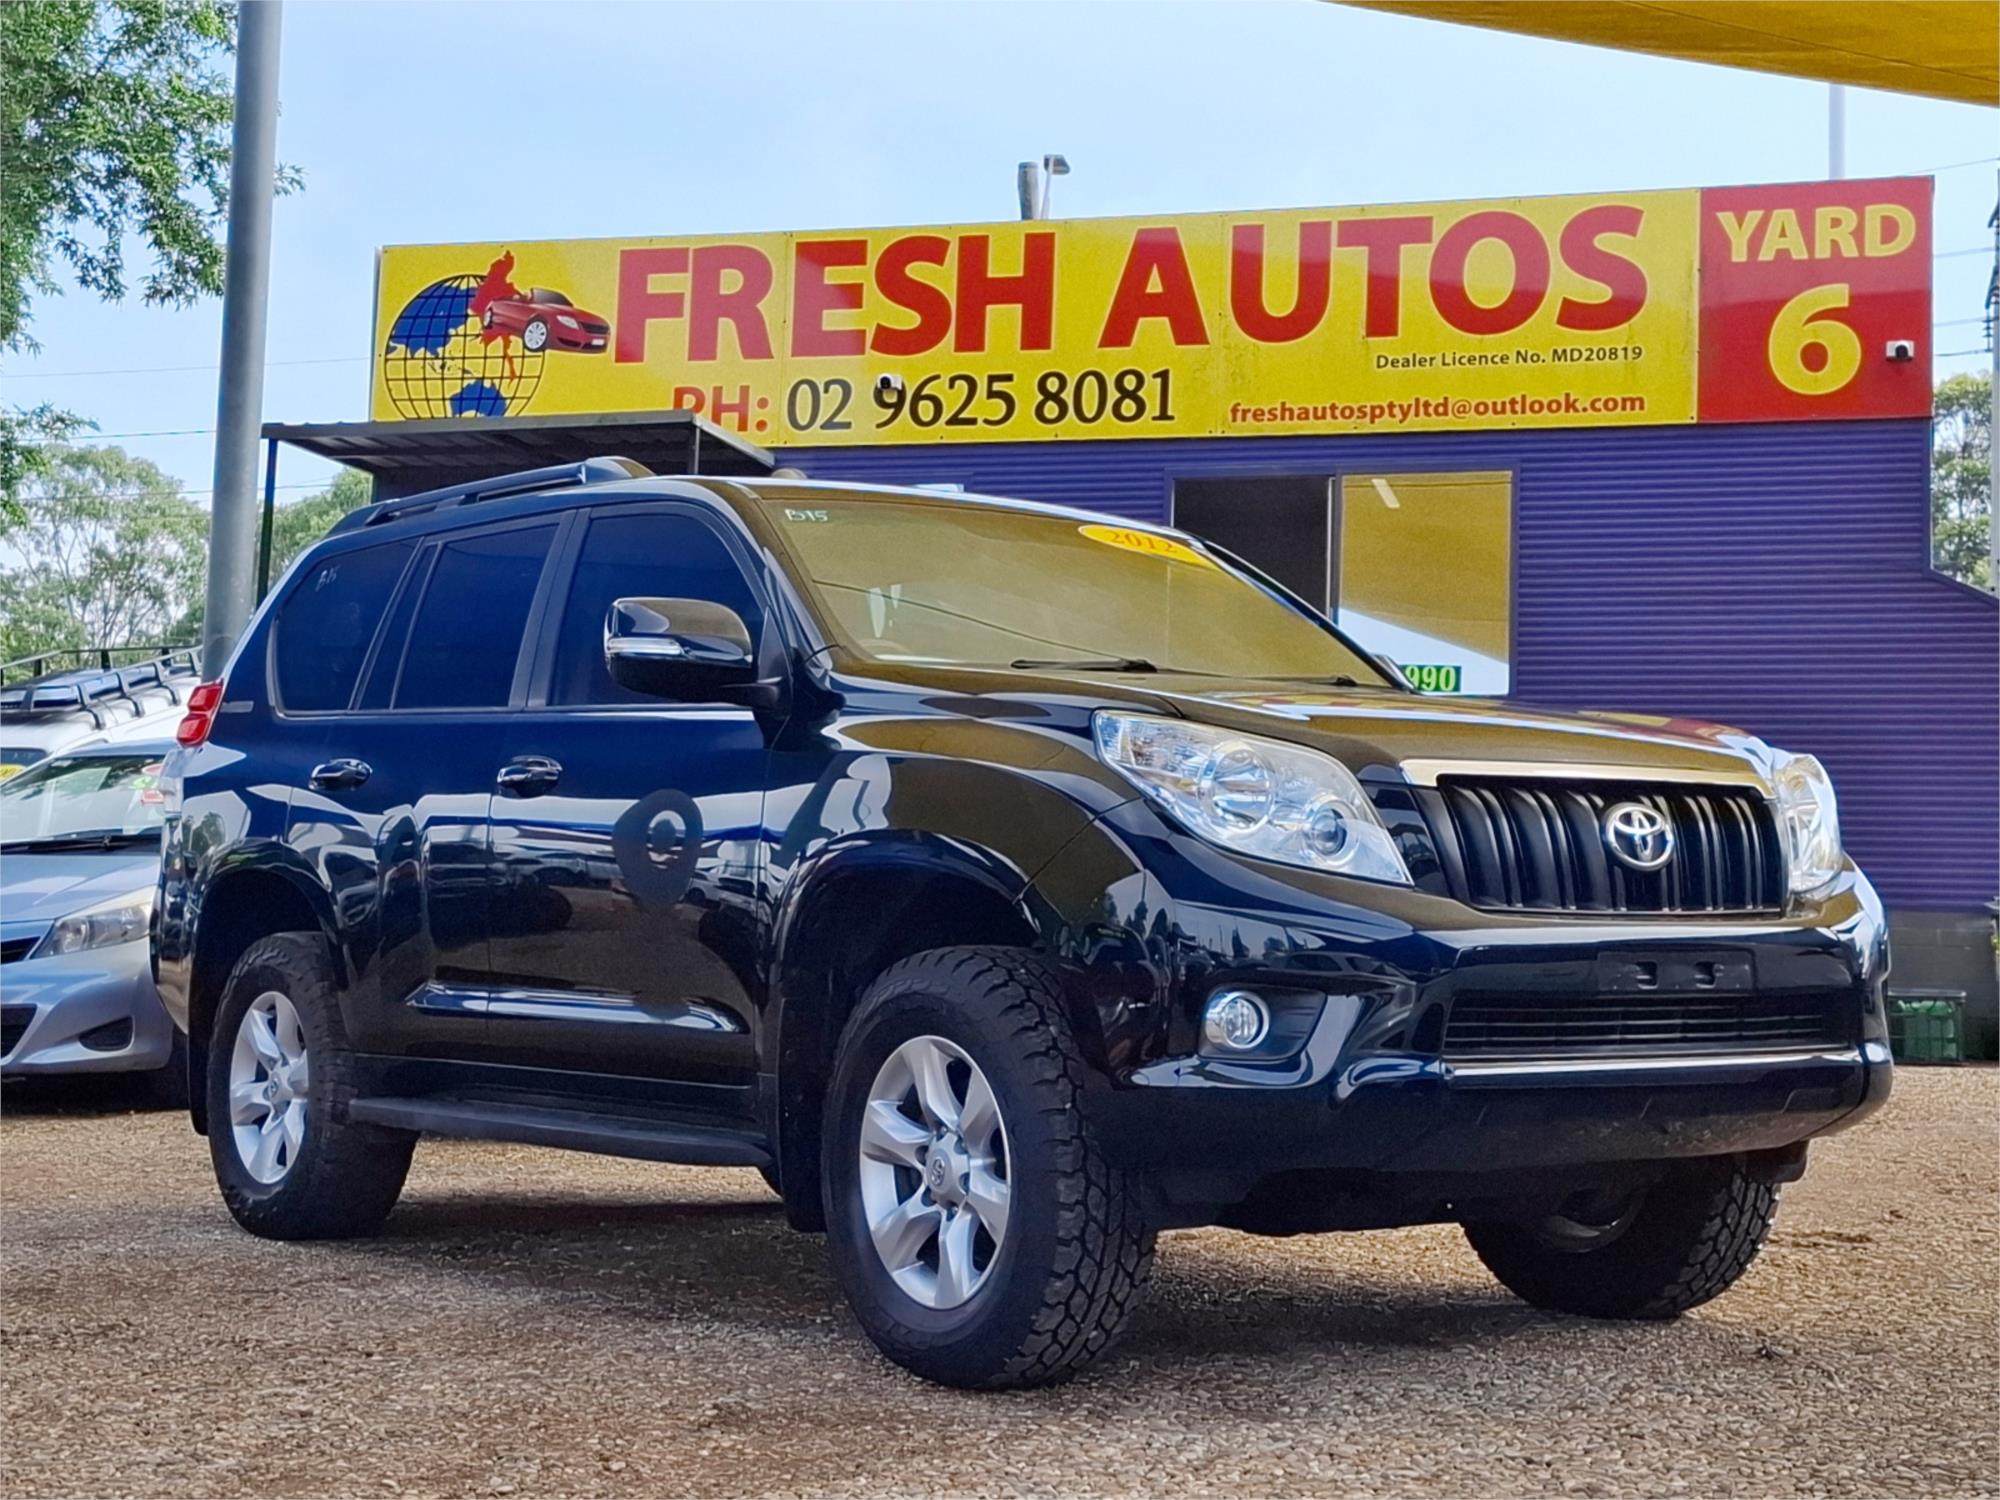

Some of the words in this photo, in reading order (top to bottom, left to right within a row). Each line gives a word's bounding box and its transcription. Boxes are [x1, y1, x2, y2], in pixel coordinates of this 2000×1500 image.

[1715, 203, 1917, 263] YARD
[614, 231, 1057, 364] FRESH
[1097, 204, 1649, 349] AUTOS
[1375, 353, 1436, 369] Dealer
[1441, 351, 1510, 367] Licence
[1515, 349, 1546, 364] No.
[1552, 346, 1643, 363] MD20819
[1768, 282, 1862, 396] 6
[786, 378, 853, 432] 02
[873, 373, 1017, 430] 9625
[1034, 368, 1176, 426] 8081
[1229, 391, 1646, 424] freshautosptyltd@outlook.com
[1104, 530, 1178, 554] 2012
[1405, 664, 1457, 692] 990
